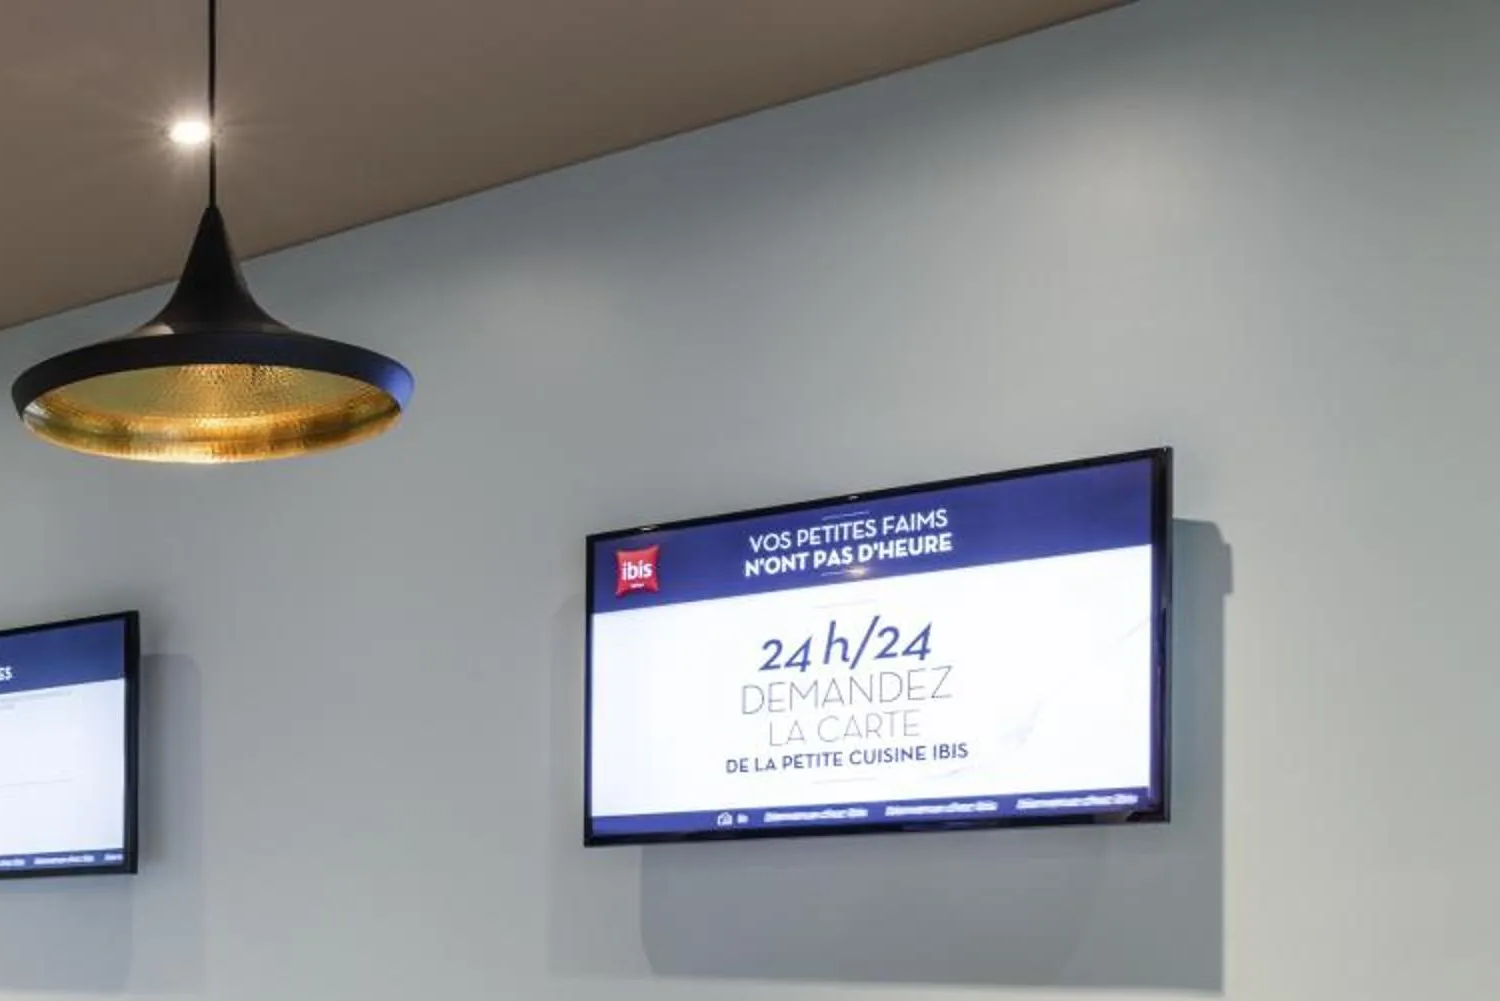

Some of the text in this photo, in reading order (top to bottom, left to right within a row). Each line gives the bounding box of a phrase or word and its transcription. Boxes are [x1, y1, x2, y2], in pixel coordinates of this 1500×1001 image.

[750, 508, 948, 553] VOS PETITES FAIMS
[621, 560, 653, 581] ibis
[745, 532, 953, 577] N'ONT PAS D'HEURE
[758, 636, 812, 672] 24
[741, 665, 953, 715] DEMANDEZ
[769, 709, 921, 746] LA CARTE
[726, 742, 969, 774] DE LA PETITE CUISINE IBIS
